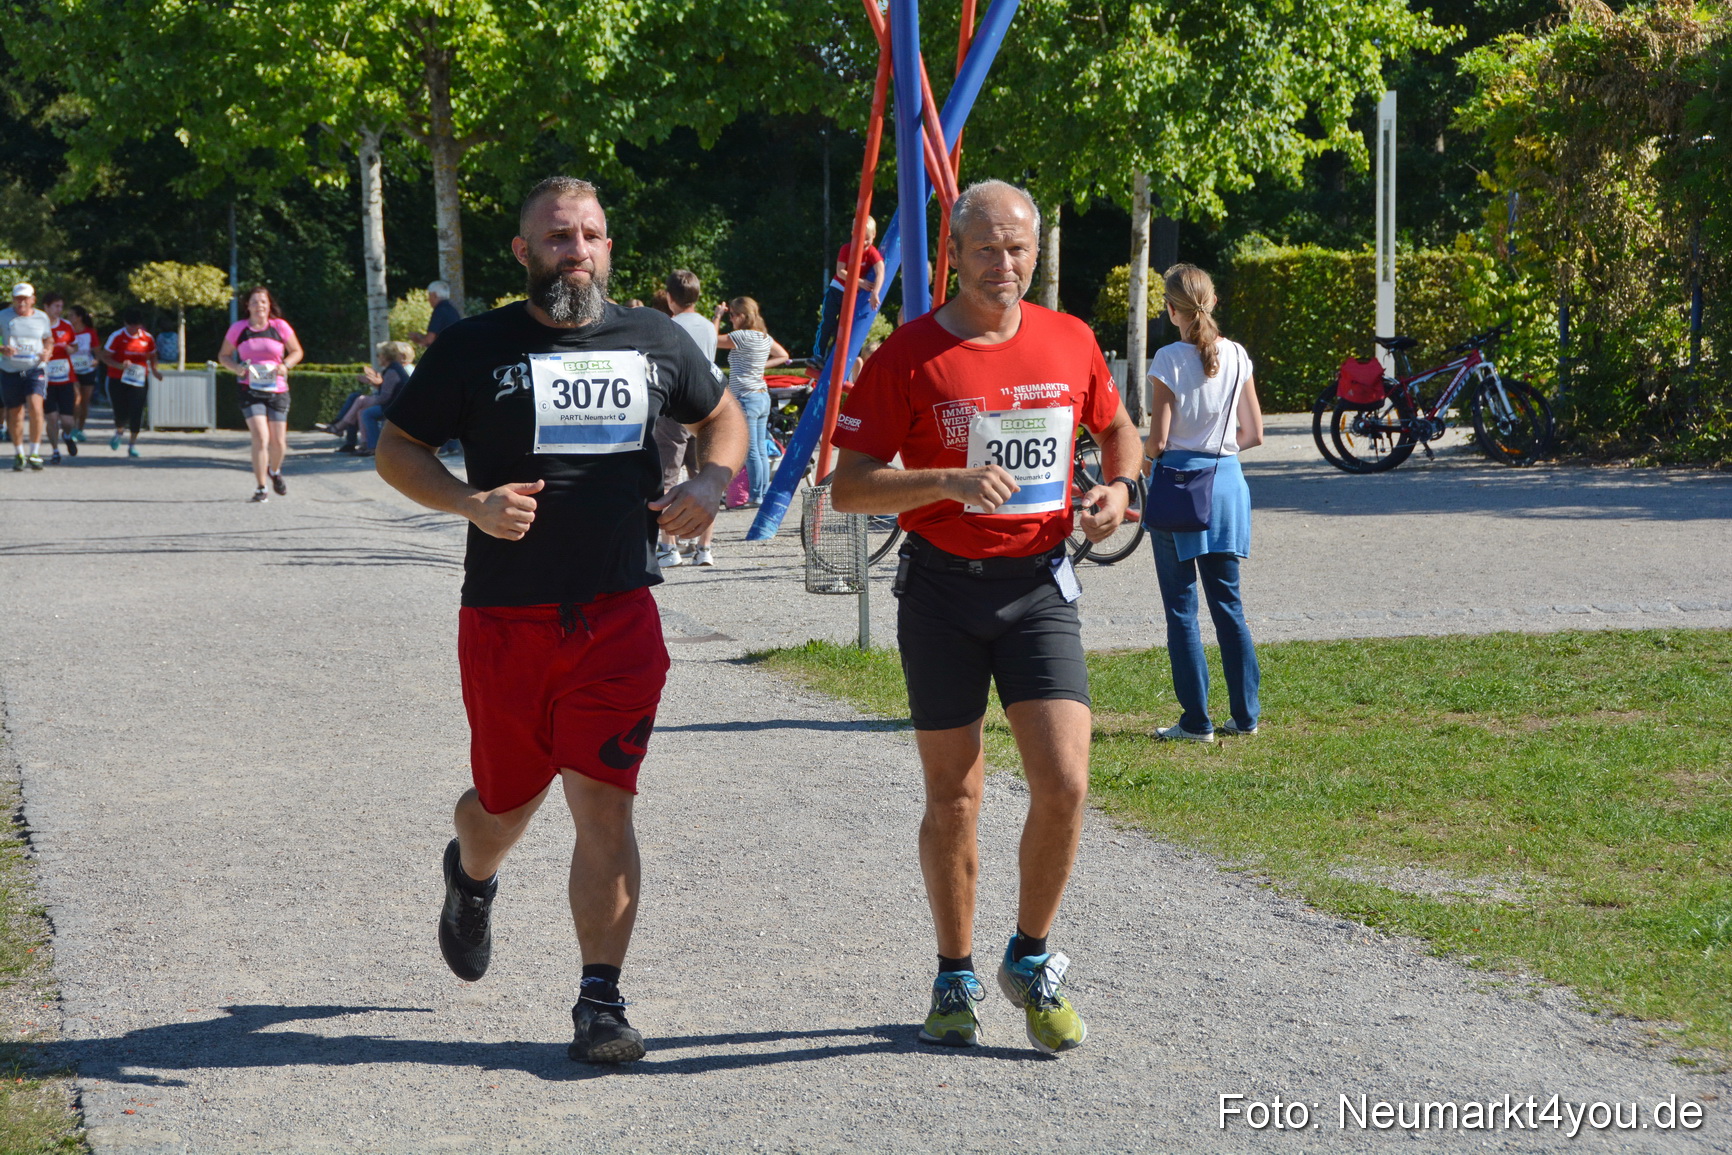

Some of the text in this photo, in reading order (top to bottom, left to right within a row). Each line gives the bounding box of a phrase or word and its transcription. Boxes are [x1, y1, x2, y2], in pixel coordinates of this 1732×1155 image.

[563, 360, 613, 371] BOCK
[552, 378, 631, 409] 3076
[1013, 383, 1070, 393] NEUMARKTER
[1013, 391, 1061, 401] STADTLAUF
[838, 414, 862, 427] DERER
[1001, 418, 1047, 430] BOCK
[945, 425, 968, 438] NE
[947, 437, 968, 447] MAR
[985, 437, 1057, 470] 3063
